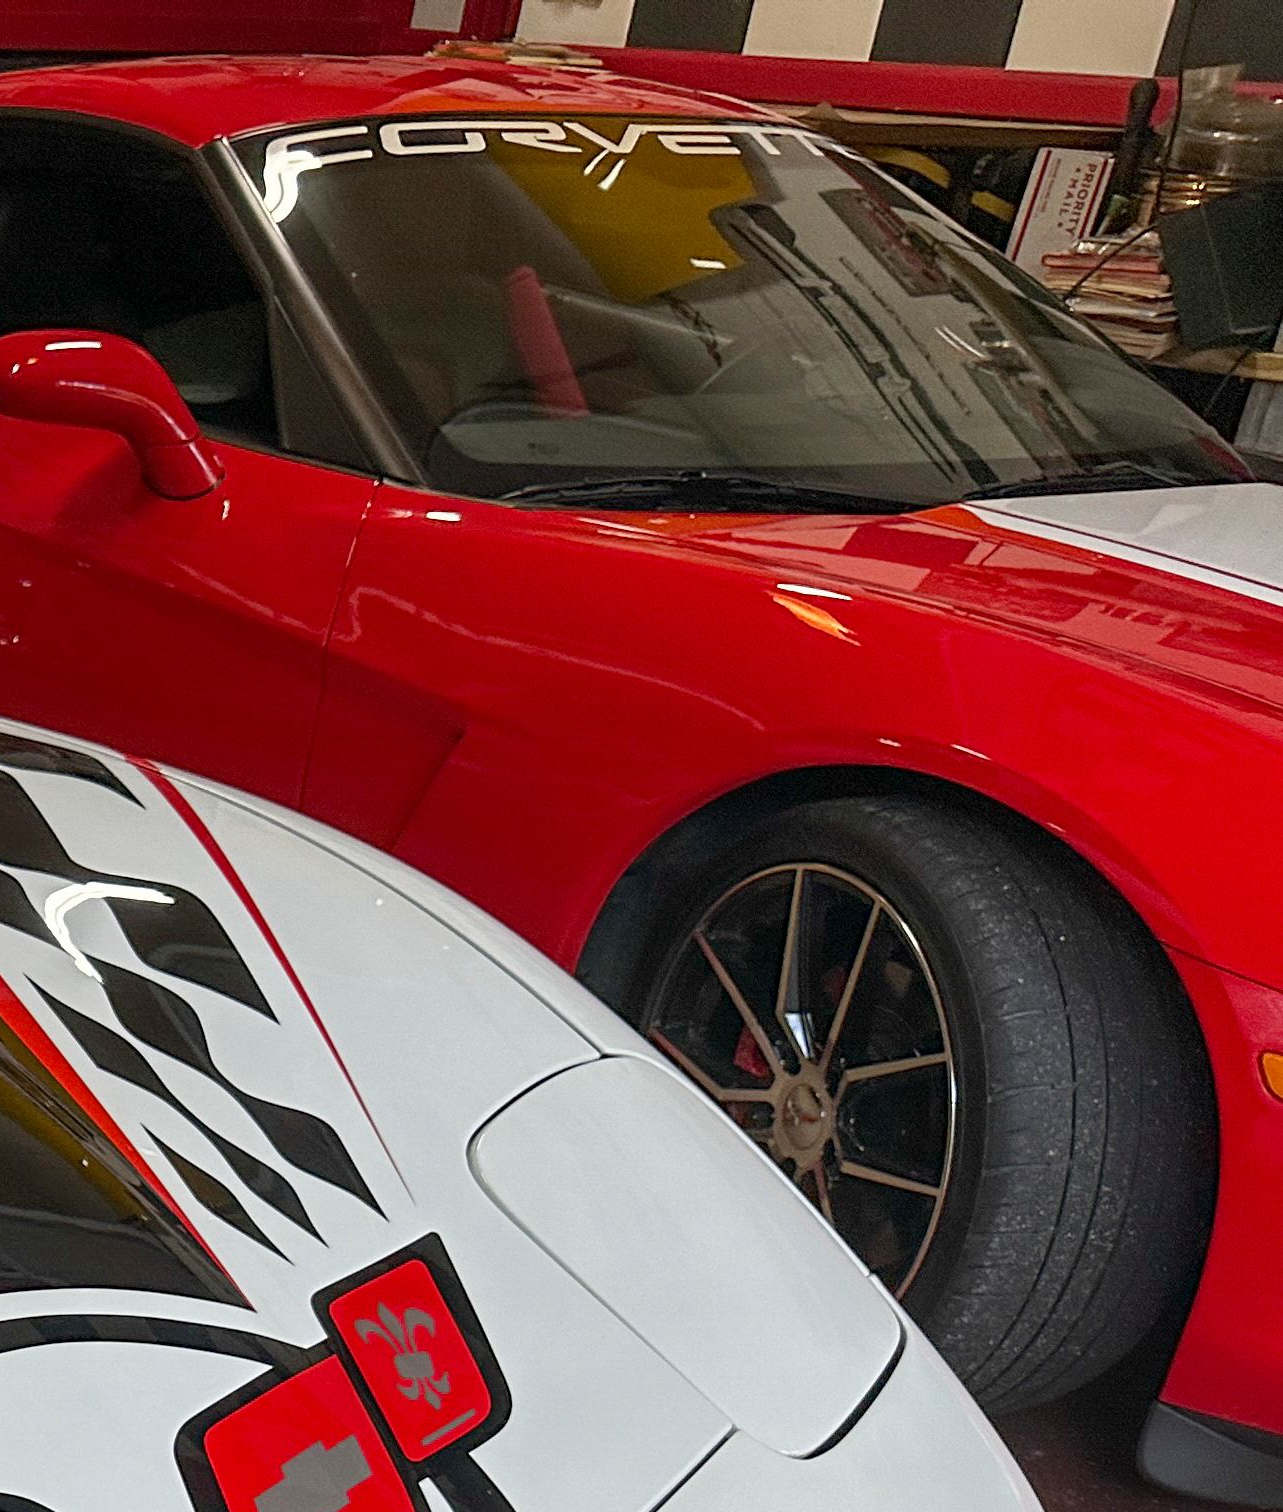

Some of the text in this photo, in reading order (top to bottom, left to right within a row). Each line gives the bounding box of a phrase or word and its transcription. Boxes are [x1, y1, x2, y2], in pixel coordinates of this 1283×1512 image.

[264, 120, 828, 182] CORVETT
[1059, 178, 1078, 216] MAIL
[1065, 163, 1098, 236] PRIORITY
